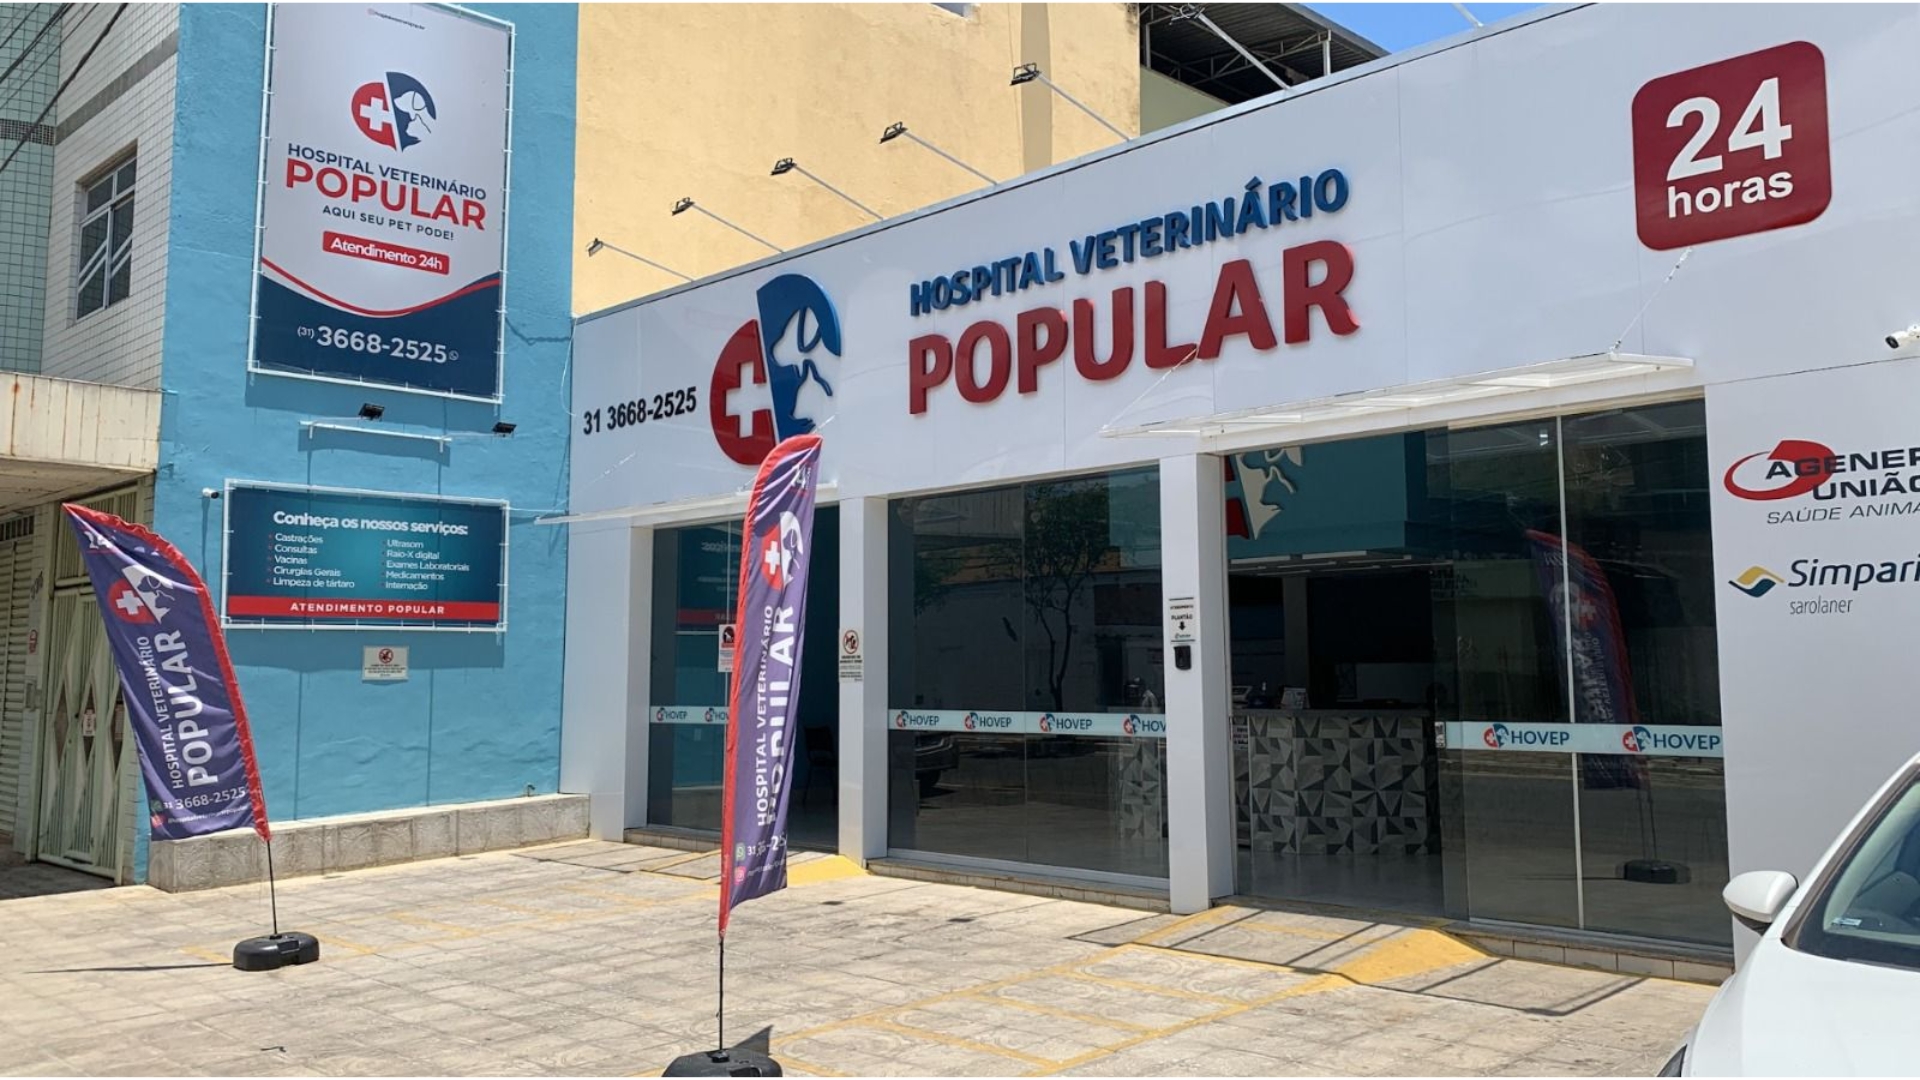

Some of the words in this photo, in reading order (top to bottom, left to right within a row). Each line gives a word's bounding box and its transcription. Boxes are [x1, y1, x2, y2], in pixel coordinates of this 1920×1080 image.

[1666, 77, 1792, 181] 24
[288, 143, 374, 175] HOSPITAL
[378, 166, 487, 201] VETERINÁRIO
[286, 158, 486, 231] POPULAR
[1667, 171, 1794, 218] horas
[322, 205, 356, 220] AQUI
[360, 212, 384, 227] SEU
[388, 218, 413, 232] PET
[416, 224, 454, 240] PODE!
[330, 237, 417, 266] Atendimento
[418, 253, 443, 270] 24h
[909, 246, 1064, 316] HOSPITAL
[1070, 167, 1349, 275] VETERINÁRIO
[909, 240, 1361, 415] POPULAR
[297, 326, 315, 339] (31)
[317, 326, 447, 363] 3668-2525
[583, 408, 600, 435] 31
[607, 386, 696, 430] 3668-2525
[273, 511, 339, 529] Conheça
[341, 518, 359, 529] os
[360, 519, 409, 531] nossos
[410, 521, 468, 536] serviços:
[1767, 507, 1842, 524] SAÚDE
[274, 544, 317, 554] Consultas
[275, 533, 323, 543] Castrações
[274, 555, 307, 565] Vacinas
[386, 550, 414, 559] Raio-X
[414, 551, 440, 560] digital
[386, 560, 418, 569] Exames
[419, 561, 470, 572] Laboratoriais
[273, 566, 313, 577] Cirurgias
[313, 568, 341, 577] Gerais
[273, 577, 311, 587] Limpeza
[312, 579, 324, 588] de
[325, 579, 355, 589] tártaro
[385, 570, 445, 580] Medicamentos
[1788, 553, 1920, 591] Simpari
[385, 581, 428, 591] Internação
[290, 602, 383, 613] ATENDIMENTO
[388, 604, 445, 615] POPULAR
[1790, 596, 1853, 614] sarolaner
[757, 605, 774, 728] VETERINÁRIO
[138, 636, 171, 723] VETERINÁRIO
[154, 629, 218, 787] POPULAR
[909, 715, 939, 726] HOVEP
[980, 716, 1012, 728] HOVEP
[1056, 718, 1093, 730] HOVEP
[1511, 731, 1570, 745] HOVEP
[1653, 733, 1720, 750] HOVEP
[163, 724, 184, 789] HOSPITAL
[756, 732, 768, 826] HOSPITAL
[174, 786, 246, 810] 3668-2525
